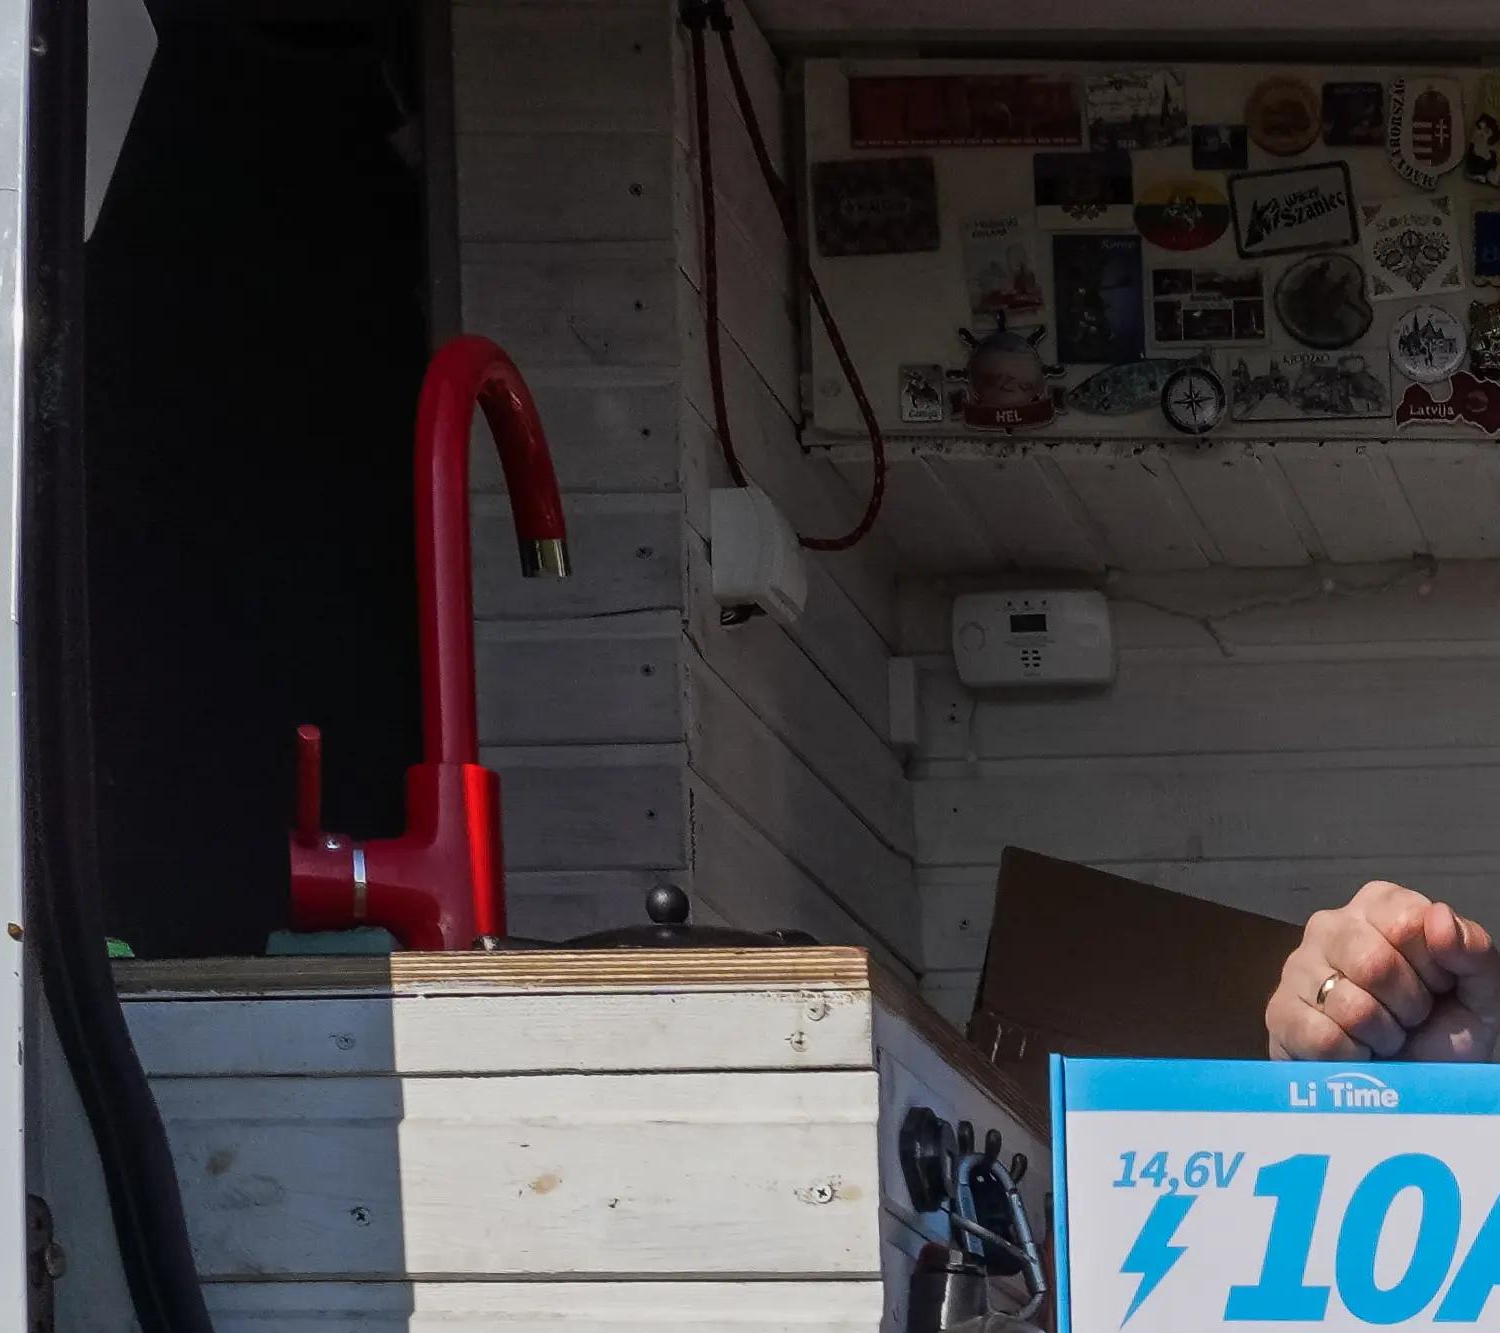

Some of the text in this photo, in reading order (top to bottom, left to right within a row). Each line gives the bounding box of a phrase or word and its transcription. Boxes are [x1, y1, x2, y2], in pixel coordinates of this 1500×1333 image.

[995, 410, 1022, 423] HEL
[1410, 404, 1455, 418] Latvija
[1290, 1080, 1399, 1108] Li Time
[1112, 1151, 1244, 1196] 14,6V
